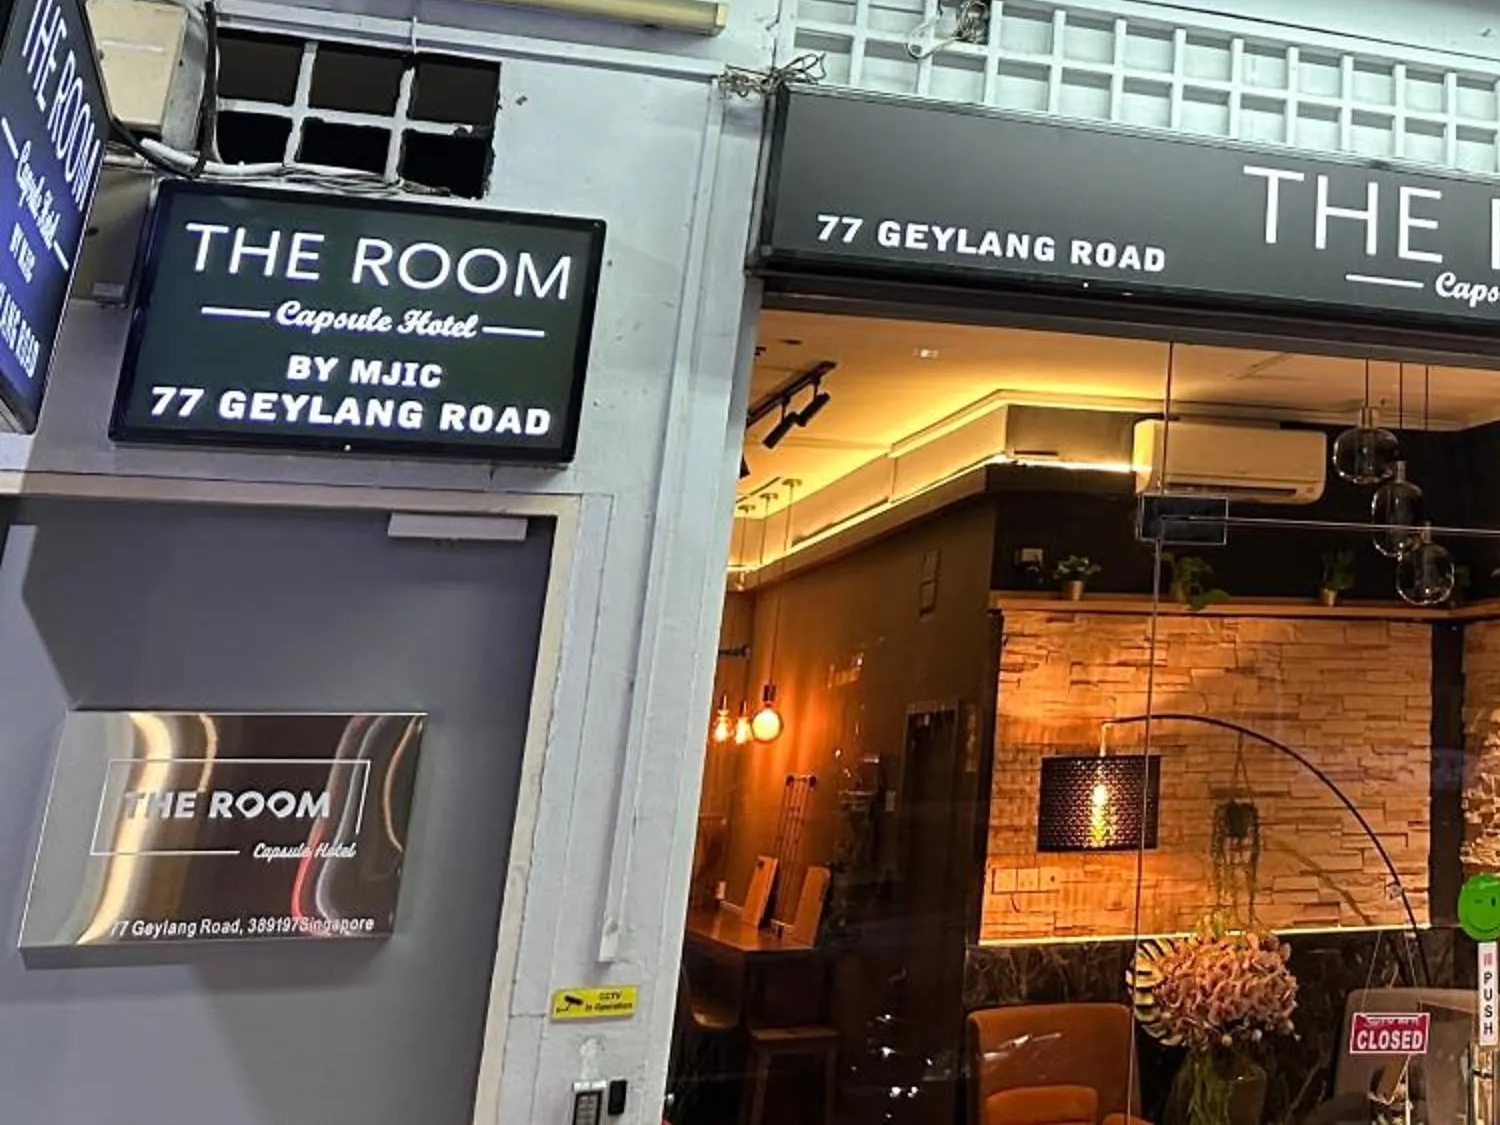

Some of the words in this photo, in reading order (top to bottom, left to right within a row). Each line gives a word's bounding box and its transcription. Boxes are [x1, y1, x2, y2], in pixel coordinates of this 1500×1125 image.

[47, 50, 100, 213] ROOM
[1242, 162, 1444, 264] THE
[186, 222, 325, 281] THE
[351, 237, 572, 300] ROOM
[817, 214, 864, 244] 77
[877, 220, 1056, 262] GEYLANG
[1070, 239, 1166, 273] ROAD
[275, 300, 393, 335] Capsule
[396, 309, 479, 339] Hotel
[287, 354, 339, 382] BY
[349, 358, 443, 388] MJIC
[151, 386, 205, 417] 77
[218, 390, 424, 429] GEYLANG
[439, 402, 551, 436] ROAD
[124, 790, 197, 819] THE
[208, 790, 332, 819] ROOM
[253, 842, 311, 862] Capsule
[200, 917, 243, 936] Road,
[1483, 971, 1494, 1036] PUSH
[1357, 1029, 1424, 1051] CLOSED
